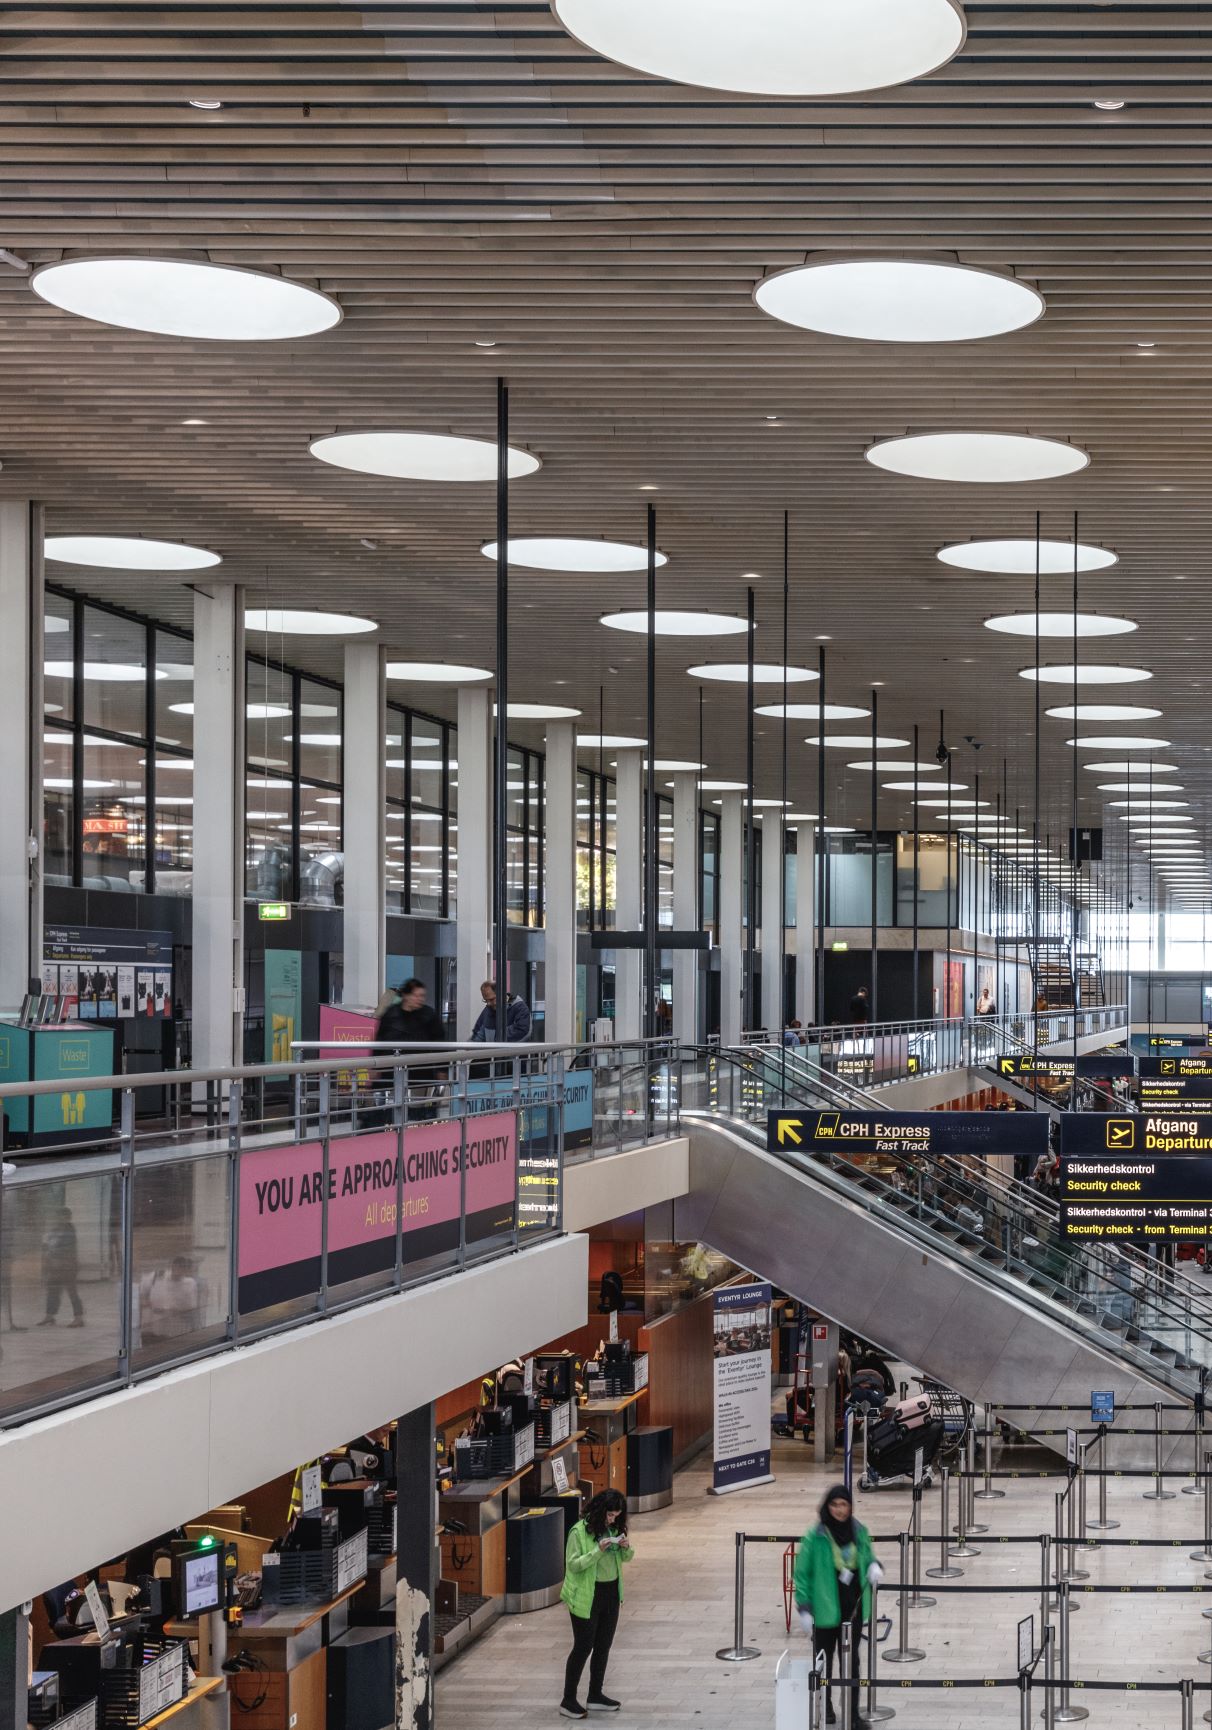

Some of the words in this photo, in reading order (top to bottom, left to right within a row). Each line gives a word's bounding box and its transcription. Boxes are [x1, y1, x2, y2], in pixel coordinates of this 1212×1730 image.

[337, 1032, 371, 1043] Waste
[63, 1049, 87, 1061] Waste
[1049, 1062, 1075, 1070] Expres
[1180, 1059, 1206, 1067] Afgang
[818, 1128, 833, 1136] CPH
[840, 1124, 869, 1136] CPH
[874, 1124, 931, 1138] Express
[1146, 1119, 1198, 1135] Afgang
[876, 1140, 897, 1151] Fast
[901, 1140, 929, 1151] Track
[1067, 1164, 1155, 1174] Sikkerhedskontrol
[255, 1176, 294, 1215] YOU
[299, 1168, 337, 1206] ARE
[341, 1148, 448, 1197] APPROACHING
[452, 1136, 509, 1173] SECURITY
[1067, 1180, 1108, 1192] Security
[1111, 1180, 1141, 1190] check
[365, 1199, 377, 1228] All
[380, 1194, 429, 1227] departures
[1067, 1208, 1146, 1217] Sikkerhedskontrol
[1154, 1208, 1167, 1217] via
[1170, 1208, 1207, 1217] Terminal
[1067, 1225, 1104, 1236] Security
[1106, 1225, 1134, 1234] check
[1144, 1225, 1165, 1234] from
[1170, 1225, 1207, 1235] Terminal
[718, 1294, 741, 1303] EVENTYR
[743, 1290, 762, 1300] LOUNGE
[730, 1359, 740, 1367] your
[746, 1362, 762, 1370] Lounge
[718, 1464, 730, 1472] NEXT
[901, 1680, 912, 1688] CPH
